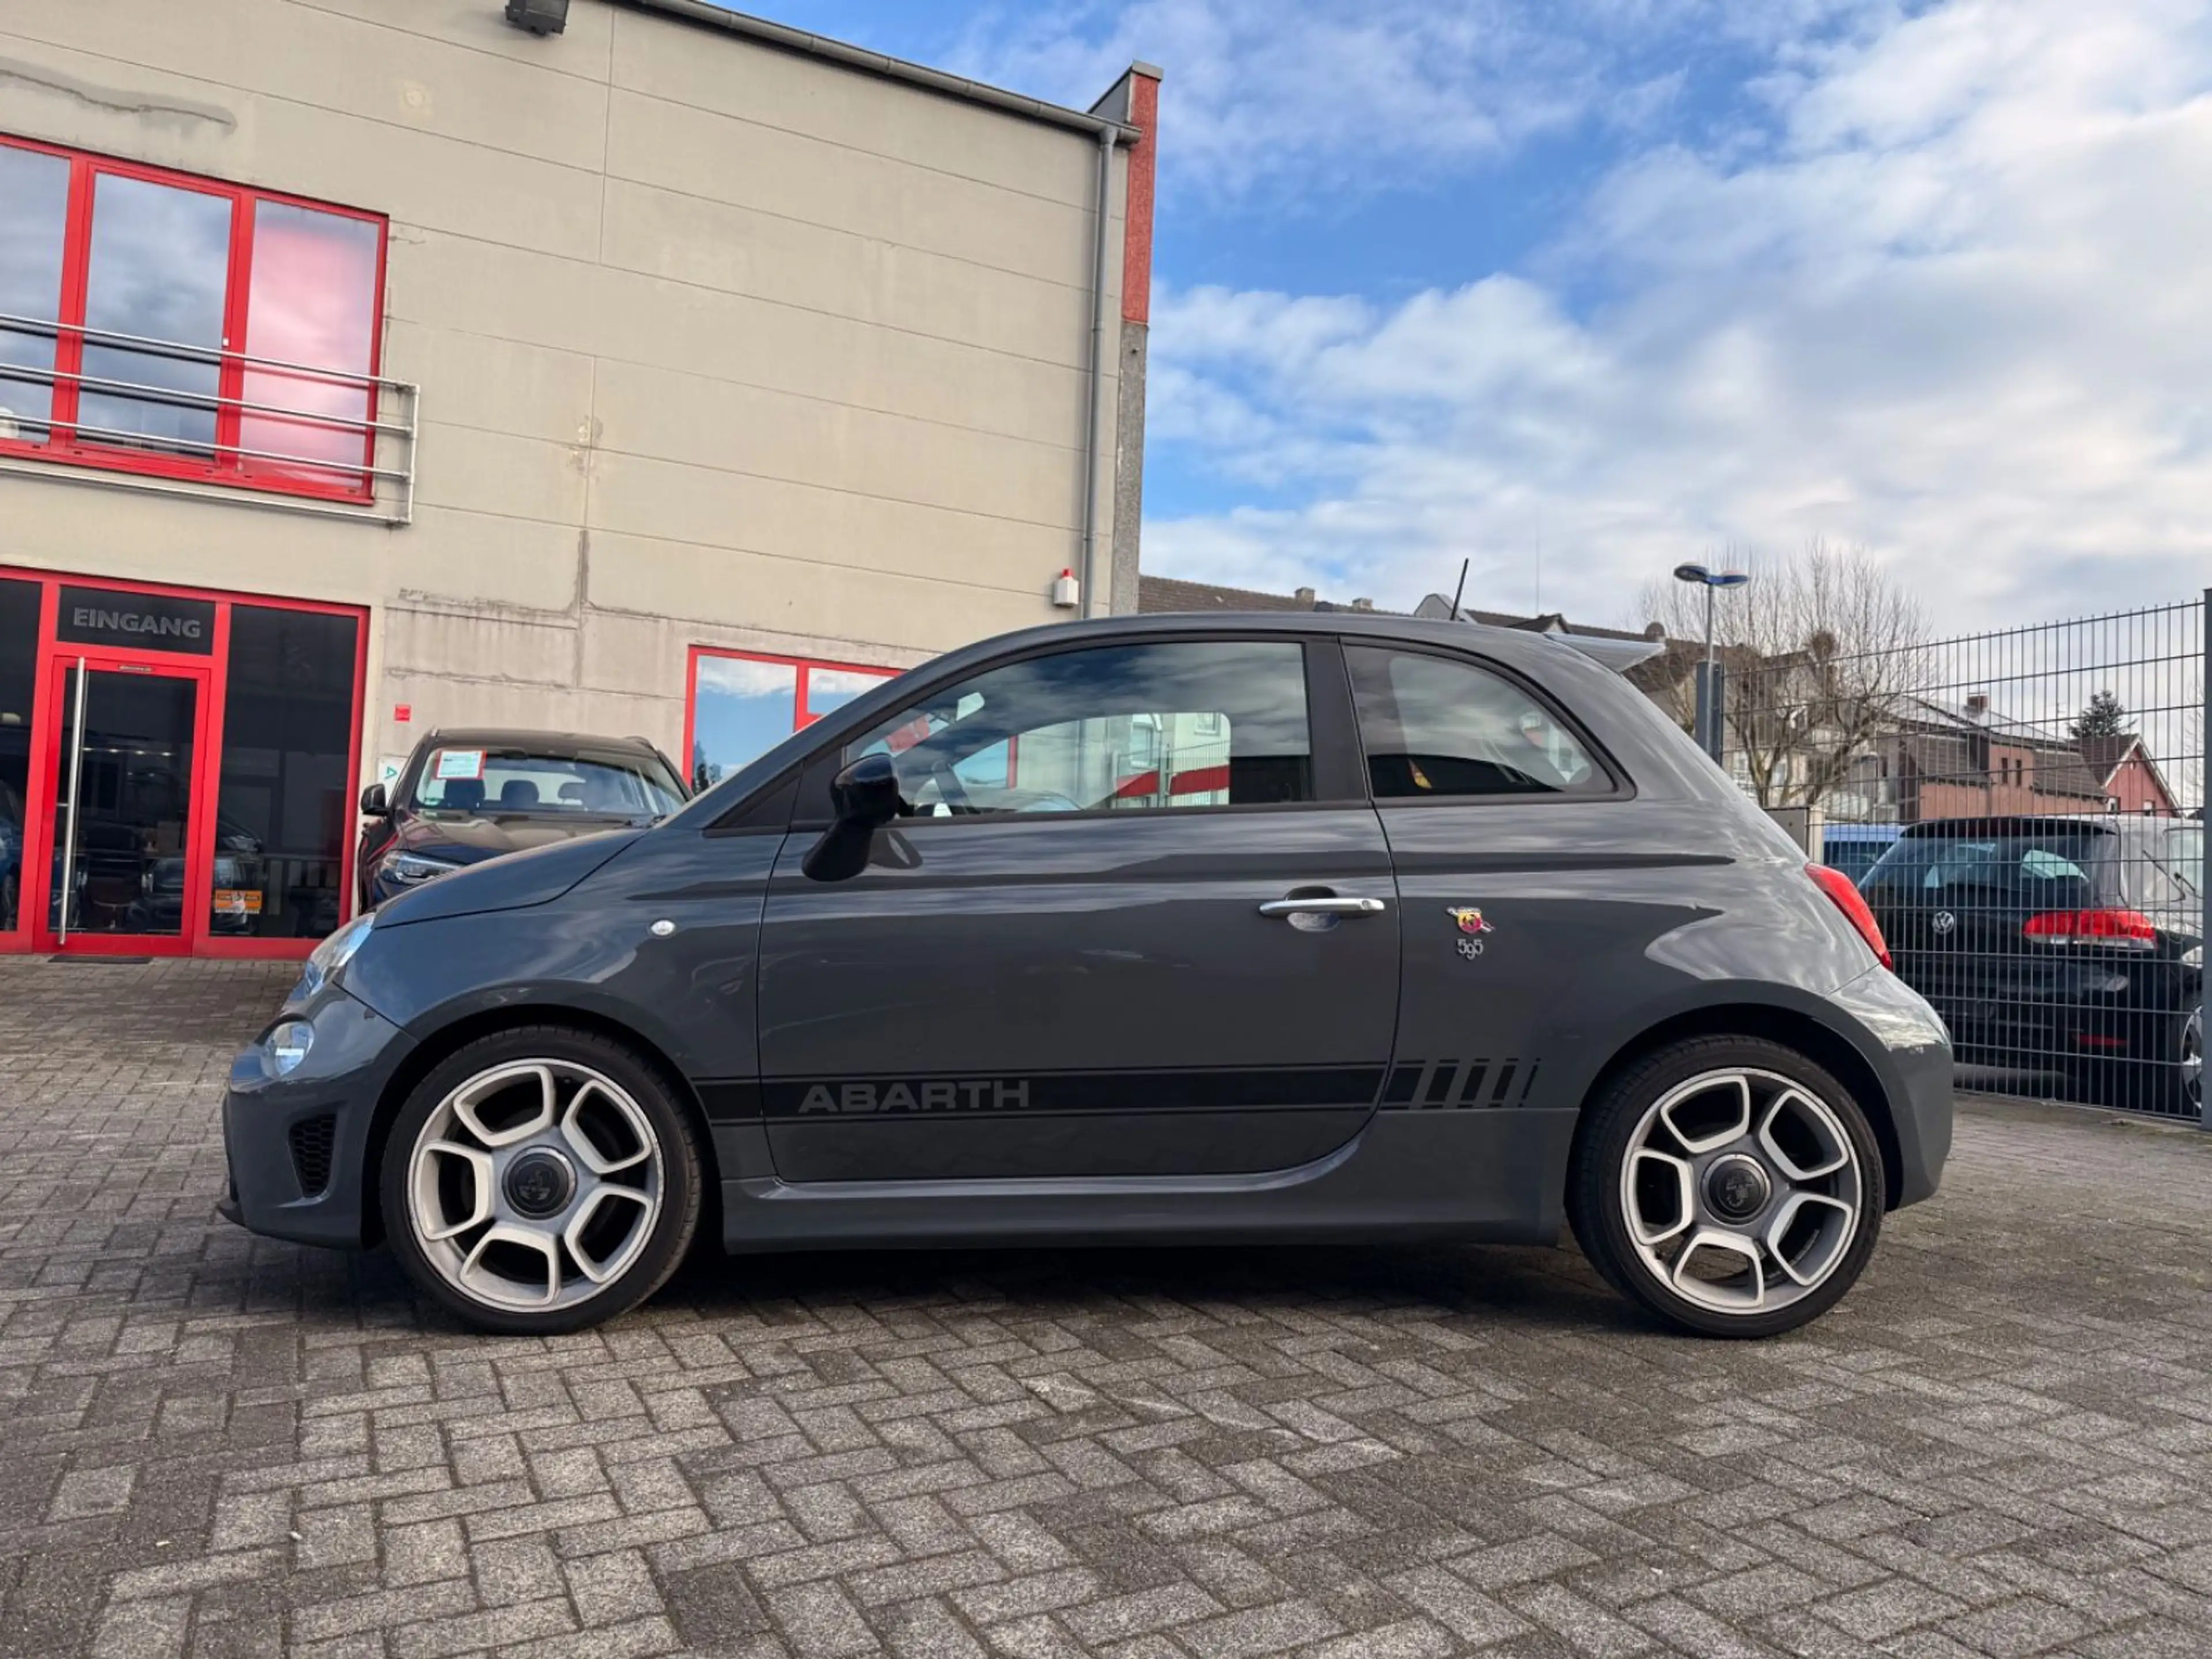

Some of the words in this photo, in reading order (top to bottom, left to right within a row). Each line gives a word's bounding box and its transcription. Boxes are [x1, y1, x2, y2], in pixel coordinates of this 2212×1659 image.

[73, 607, 201, 638] EINGANG
[1457, 938, 1483, 960] 595
[798, 1080, 1029, 1113] ABARTH
